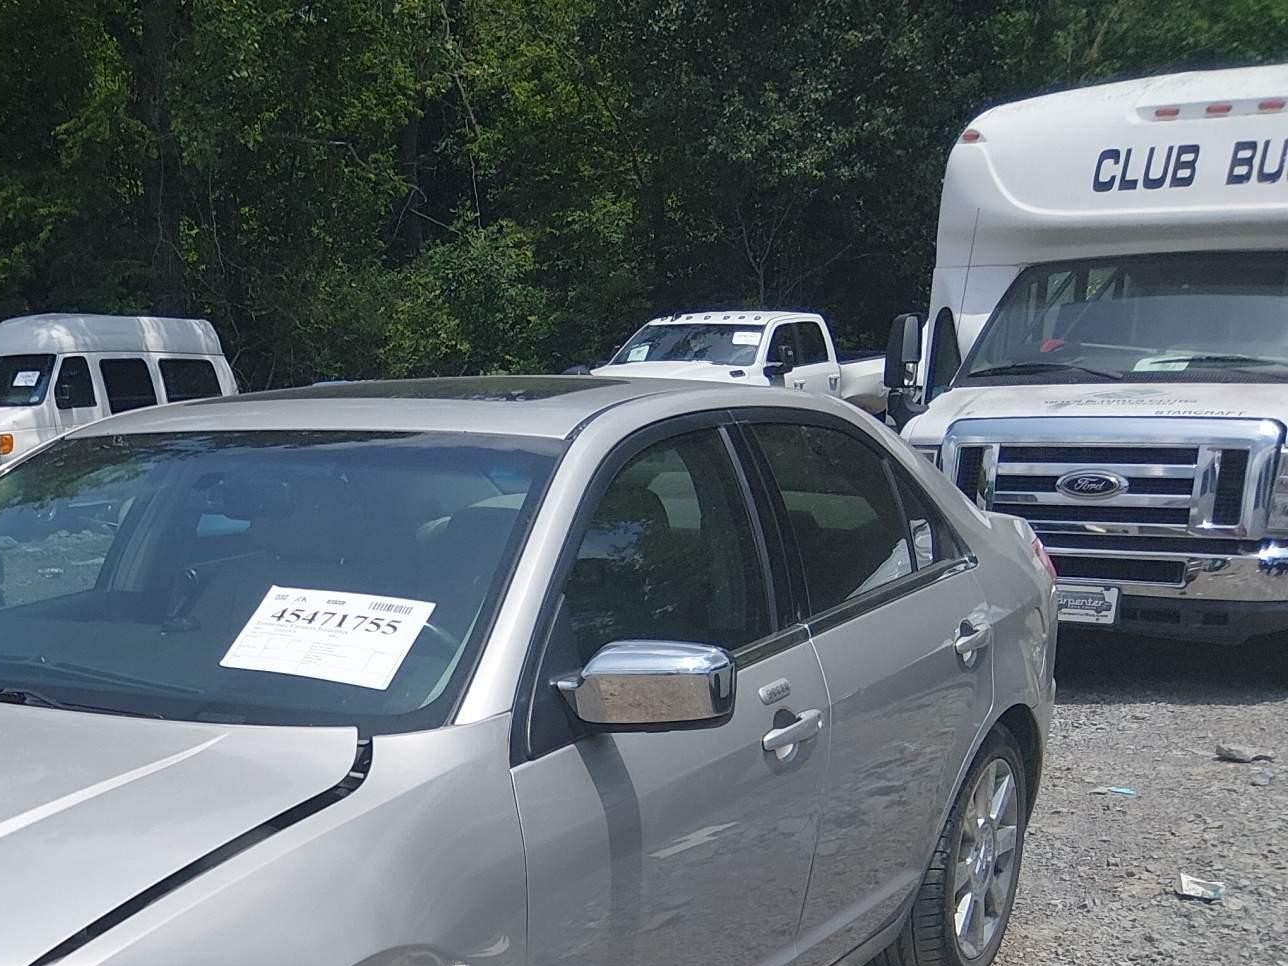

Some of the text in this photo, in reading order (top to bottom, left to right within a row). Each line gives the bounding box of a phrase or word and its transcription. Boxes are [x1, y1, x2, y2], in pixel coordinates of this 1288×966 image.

[1092, 138, 1288, 193] CLUB BU
[1074, 477, 1106, 490] Ford
[1056, 597, 1104, 608] arpenter
[270, 607, 403, 636] 45471755
